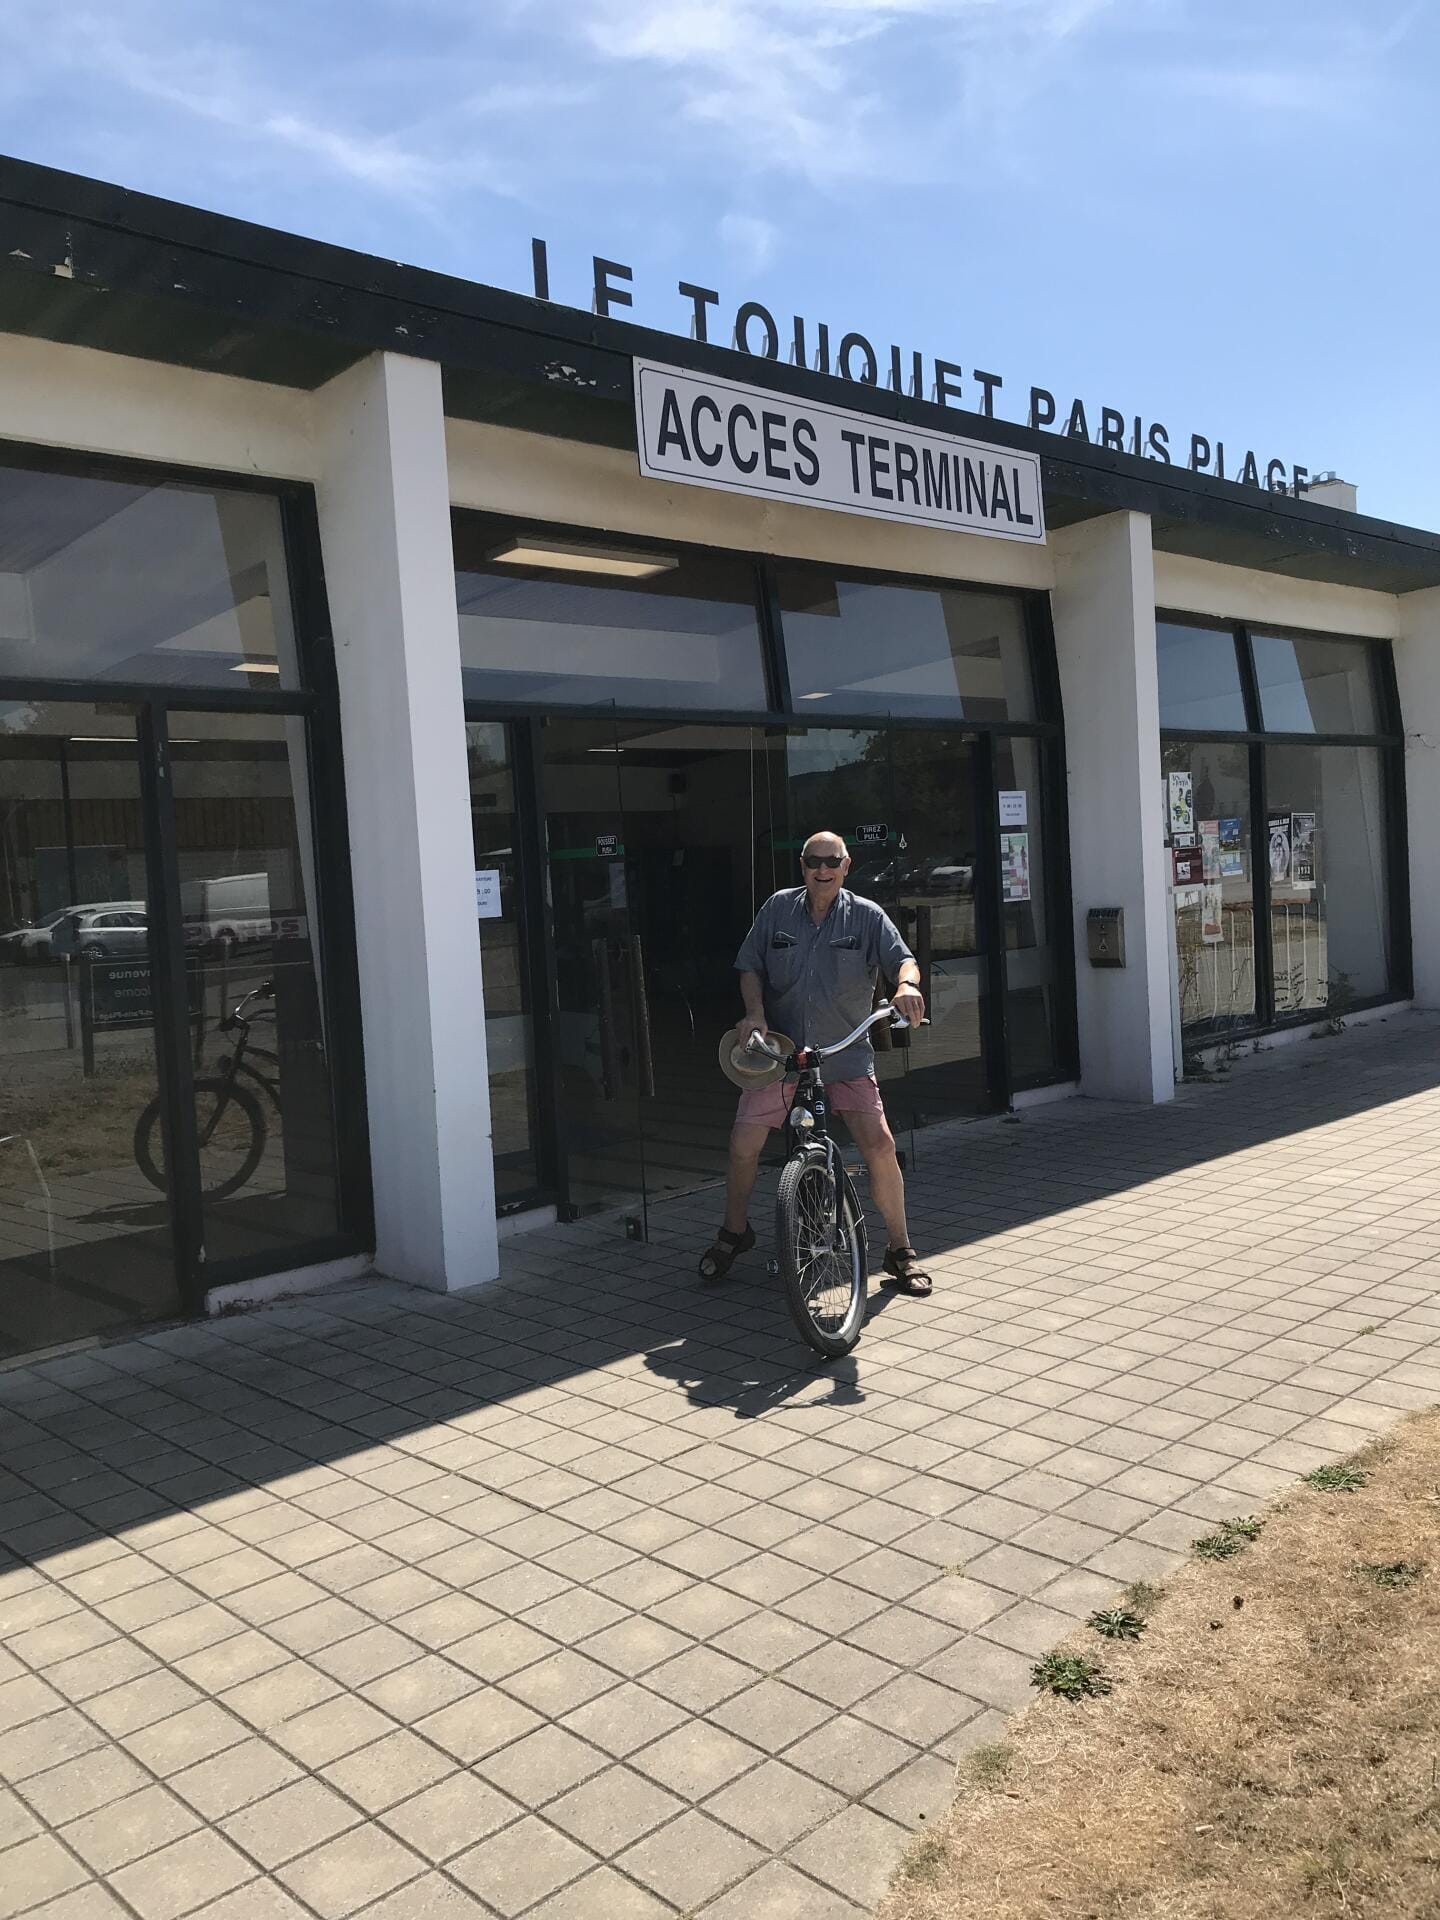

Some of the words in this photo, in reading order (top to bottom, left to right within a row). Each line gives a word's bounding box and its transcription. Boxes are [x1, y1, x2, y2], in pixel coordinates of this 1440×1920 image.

[532, 238, 633, 317] LE
[678, 281, 1003, 419] TOUQUET
[1030, 386, 1170, 465] PARIS
[1191, 433, 1309, 498] PLAGE
[657, 388, 820, 487] ACCES
[841, 430, 1034, 525] TERMINAL
[862, 825, 881, 833] TIREZ
